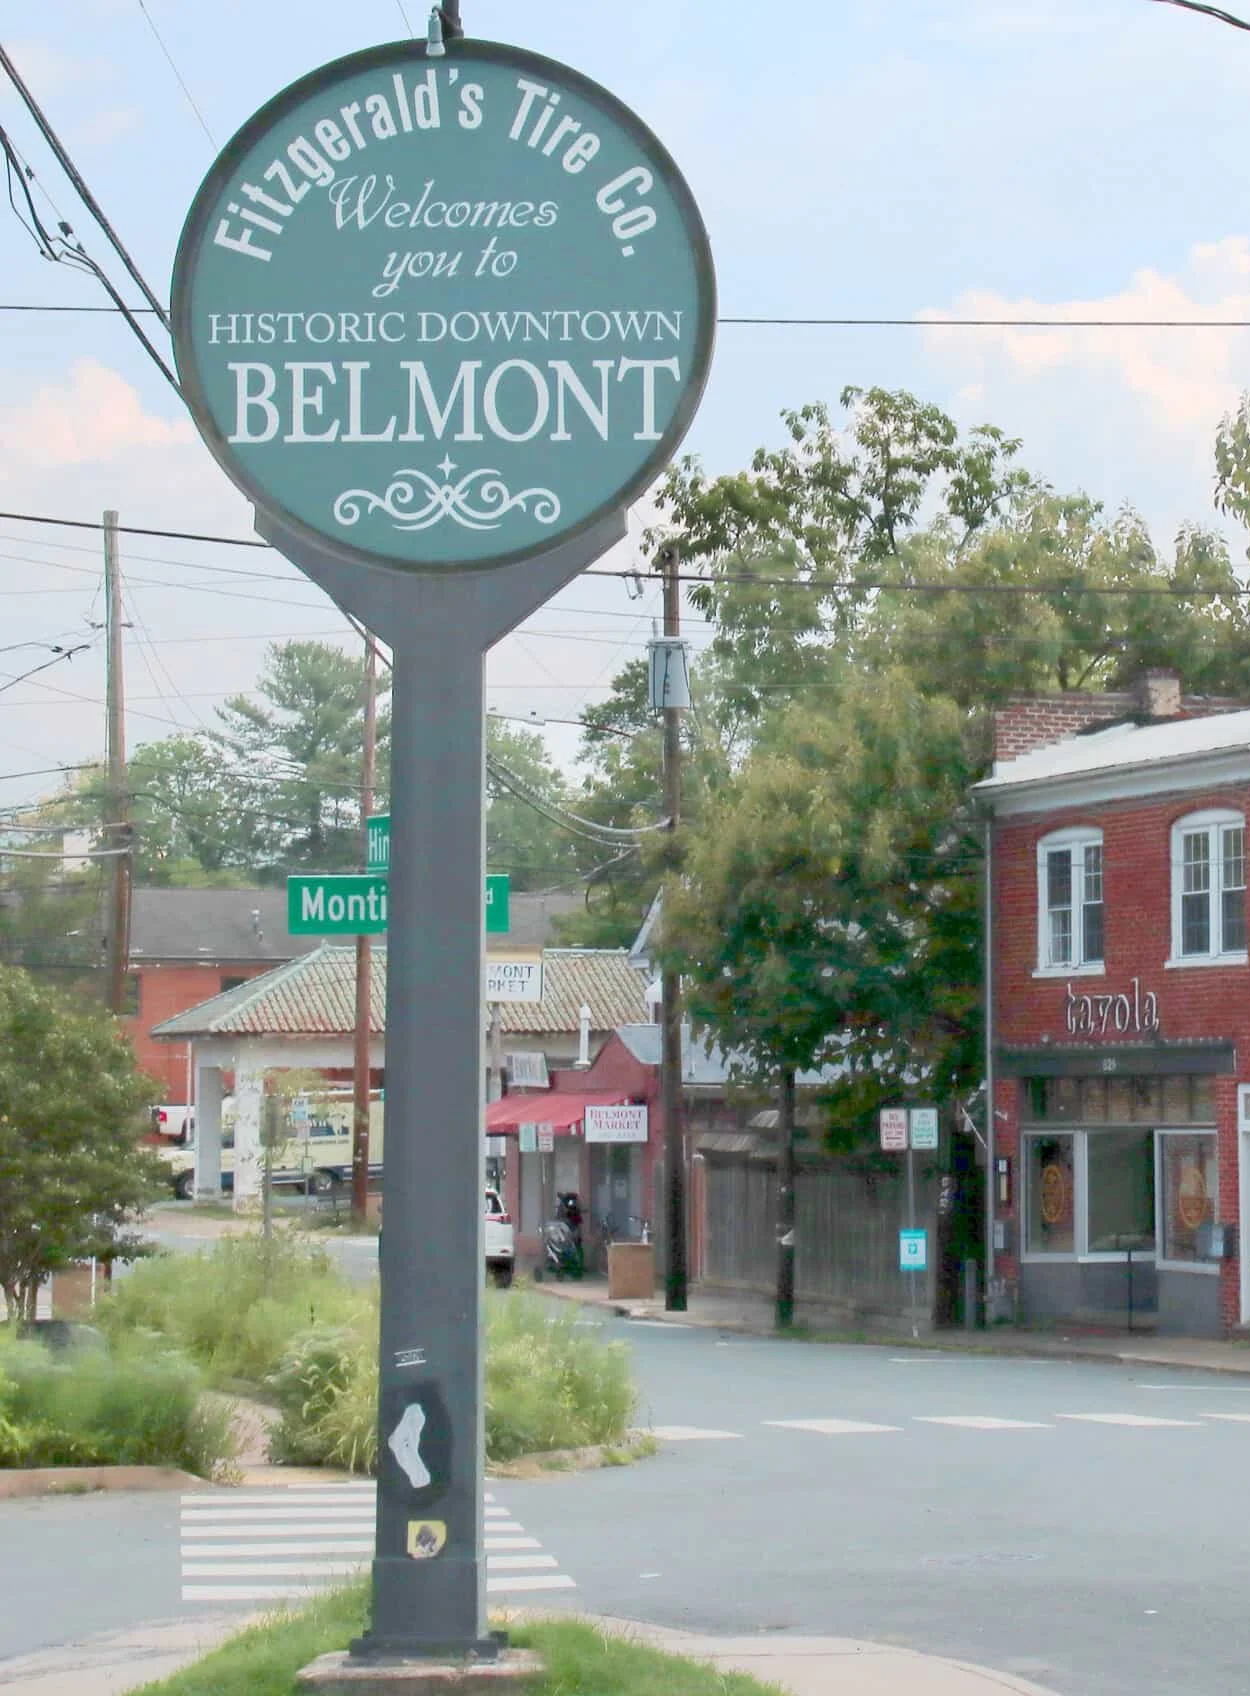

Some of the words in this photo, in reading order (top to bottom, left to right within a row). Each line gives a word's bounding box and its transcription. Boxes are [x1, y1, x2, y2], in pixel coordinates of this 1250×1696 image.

[213, 68, 484, 262] Fitzgerald's
[508, 78, 602, 175] Tire
[596, 165, 658, 258] Co.
[328, 175, 559, 232] Welcomes
[372, 247, 459, 299] you
[474, 238, 518, 278] to
[207, 311, 406, 345] HISTORIC
[417, 310, 683, 343] DOWNTOWN
[227, 357, 681, 444] BELMONT
[368, 827, 389, 862] Hin
[301, 885, 387, 922] Monti
[487, 964, 535, 979] MONT
[487, 979, 529, 993] RKET
[592, 1119, 641, 1129] MARKET
